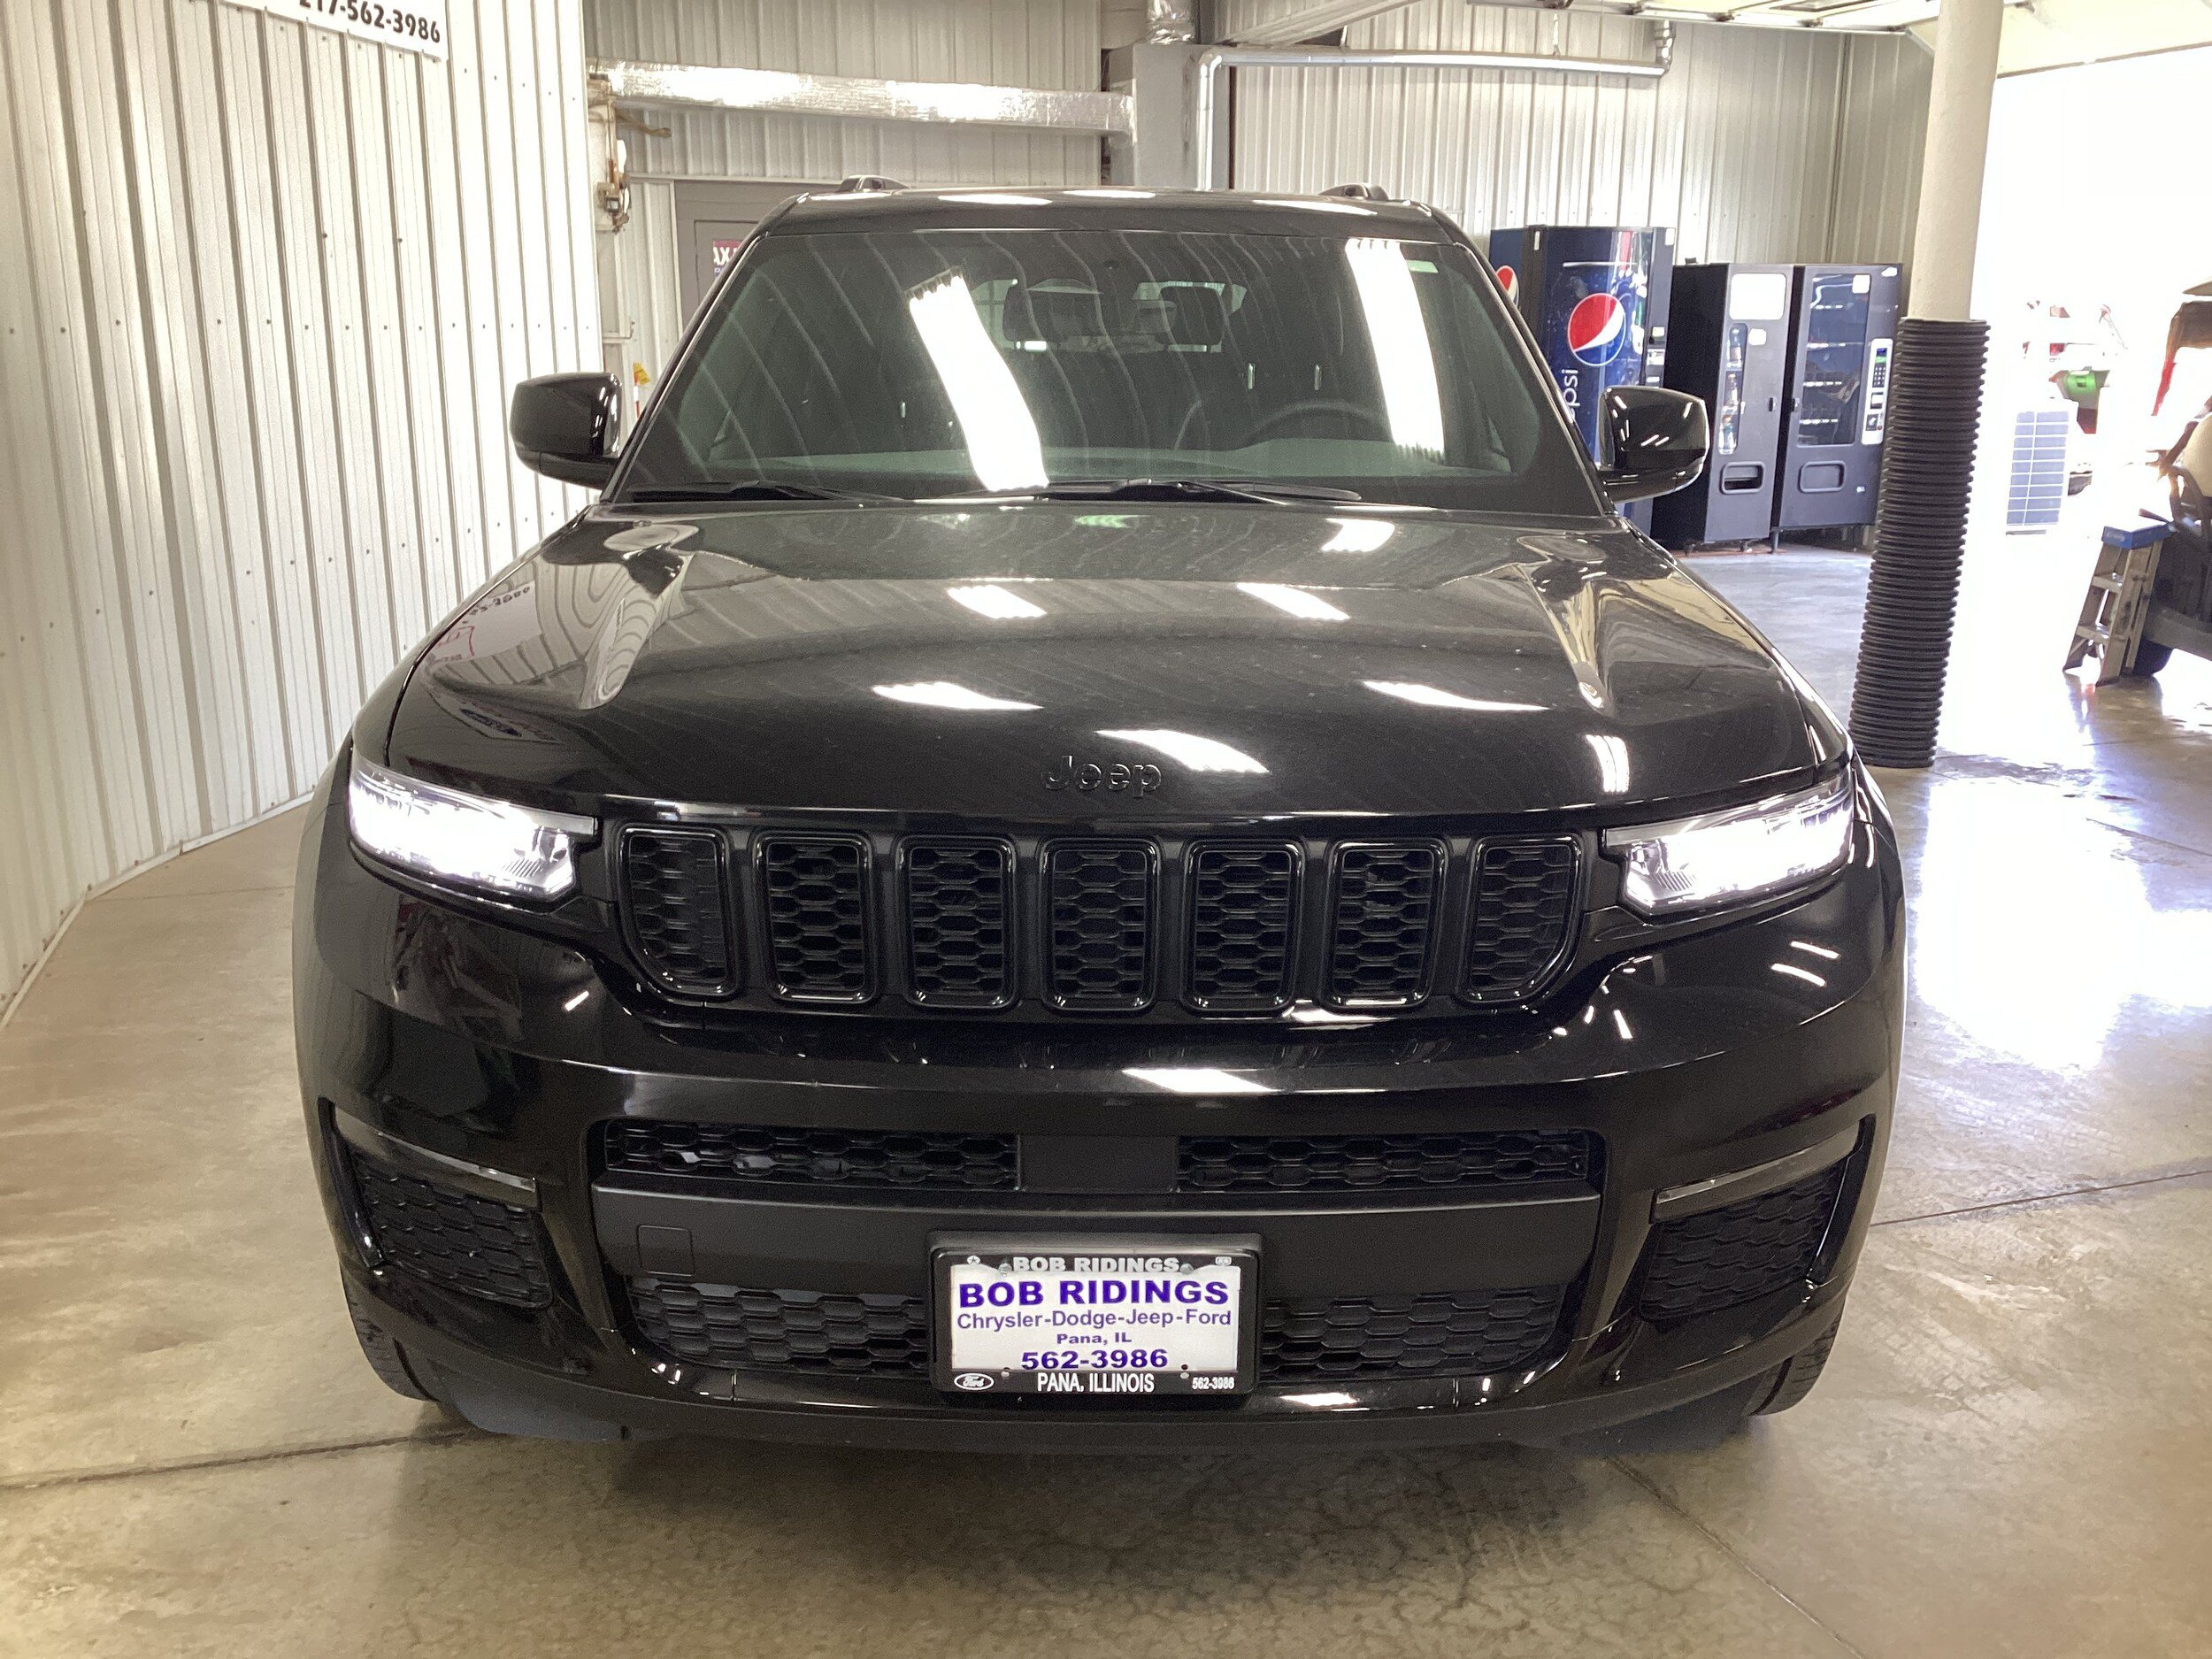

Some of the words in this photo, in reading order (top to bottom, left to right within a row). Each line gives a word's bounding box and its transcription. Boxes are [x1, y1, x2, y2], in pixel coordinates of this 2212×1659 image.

[1041, 756, 1162, 797] Jeep
[1013, 1256, 1065, 1271] BOB
[1074, 1257, 1180, 1272] RIDINGS
[959, 1281, 1044, 1308] BOB
[1059, 1279, 1229, 1305] RIDINGS
[957, 1309, 1232, 1333] Chrysler-Dodge-Jeep-Ford
[1056, 1333, 1108, 1346] Pana,
[1115, 1332, 1133, 1343] IL
[1021, 1348, 1168, 1371] 562-3986
[1037, 1372, 1085, 1393] PANA,
[1089, 1372, 1155, 1393] ILLINOIS
[1192, 1376, 1235, 1390] 562-3986
